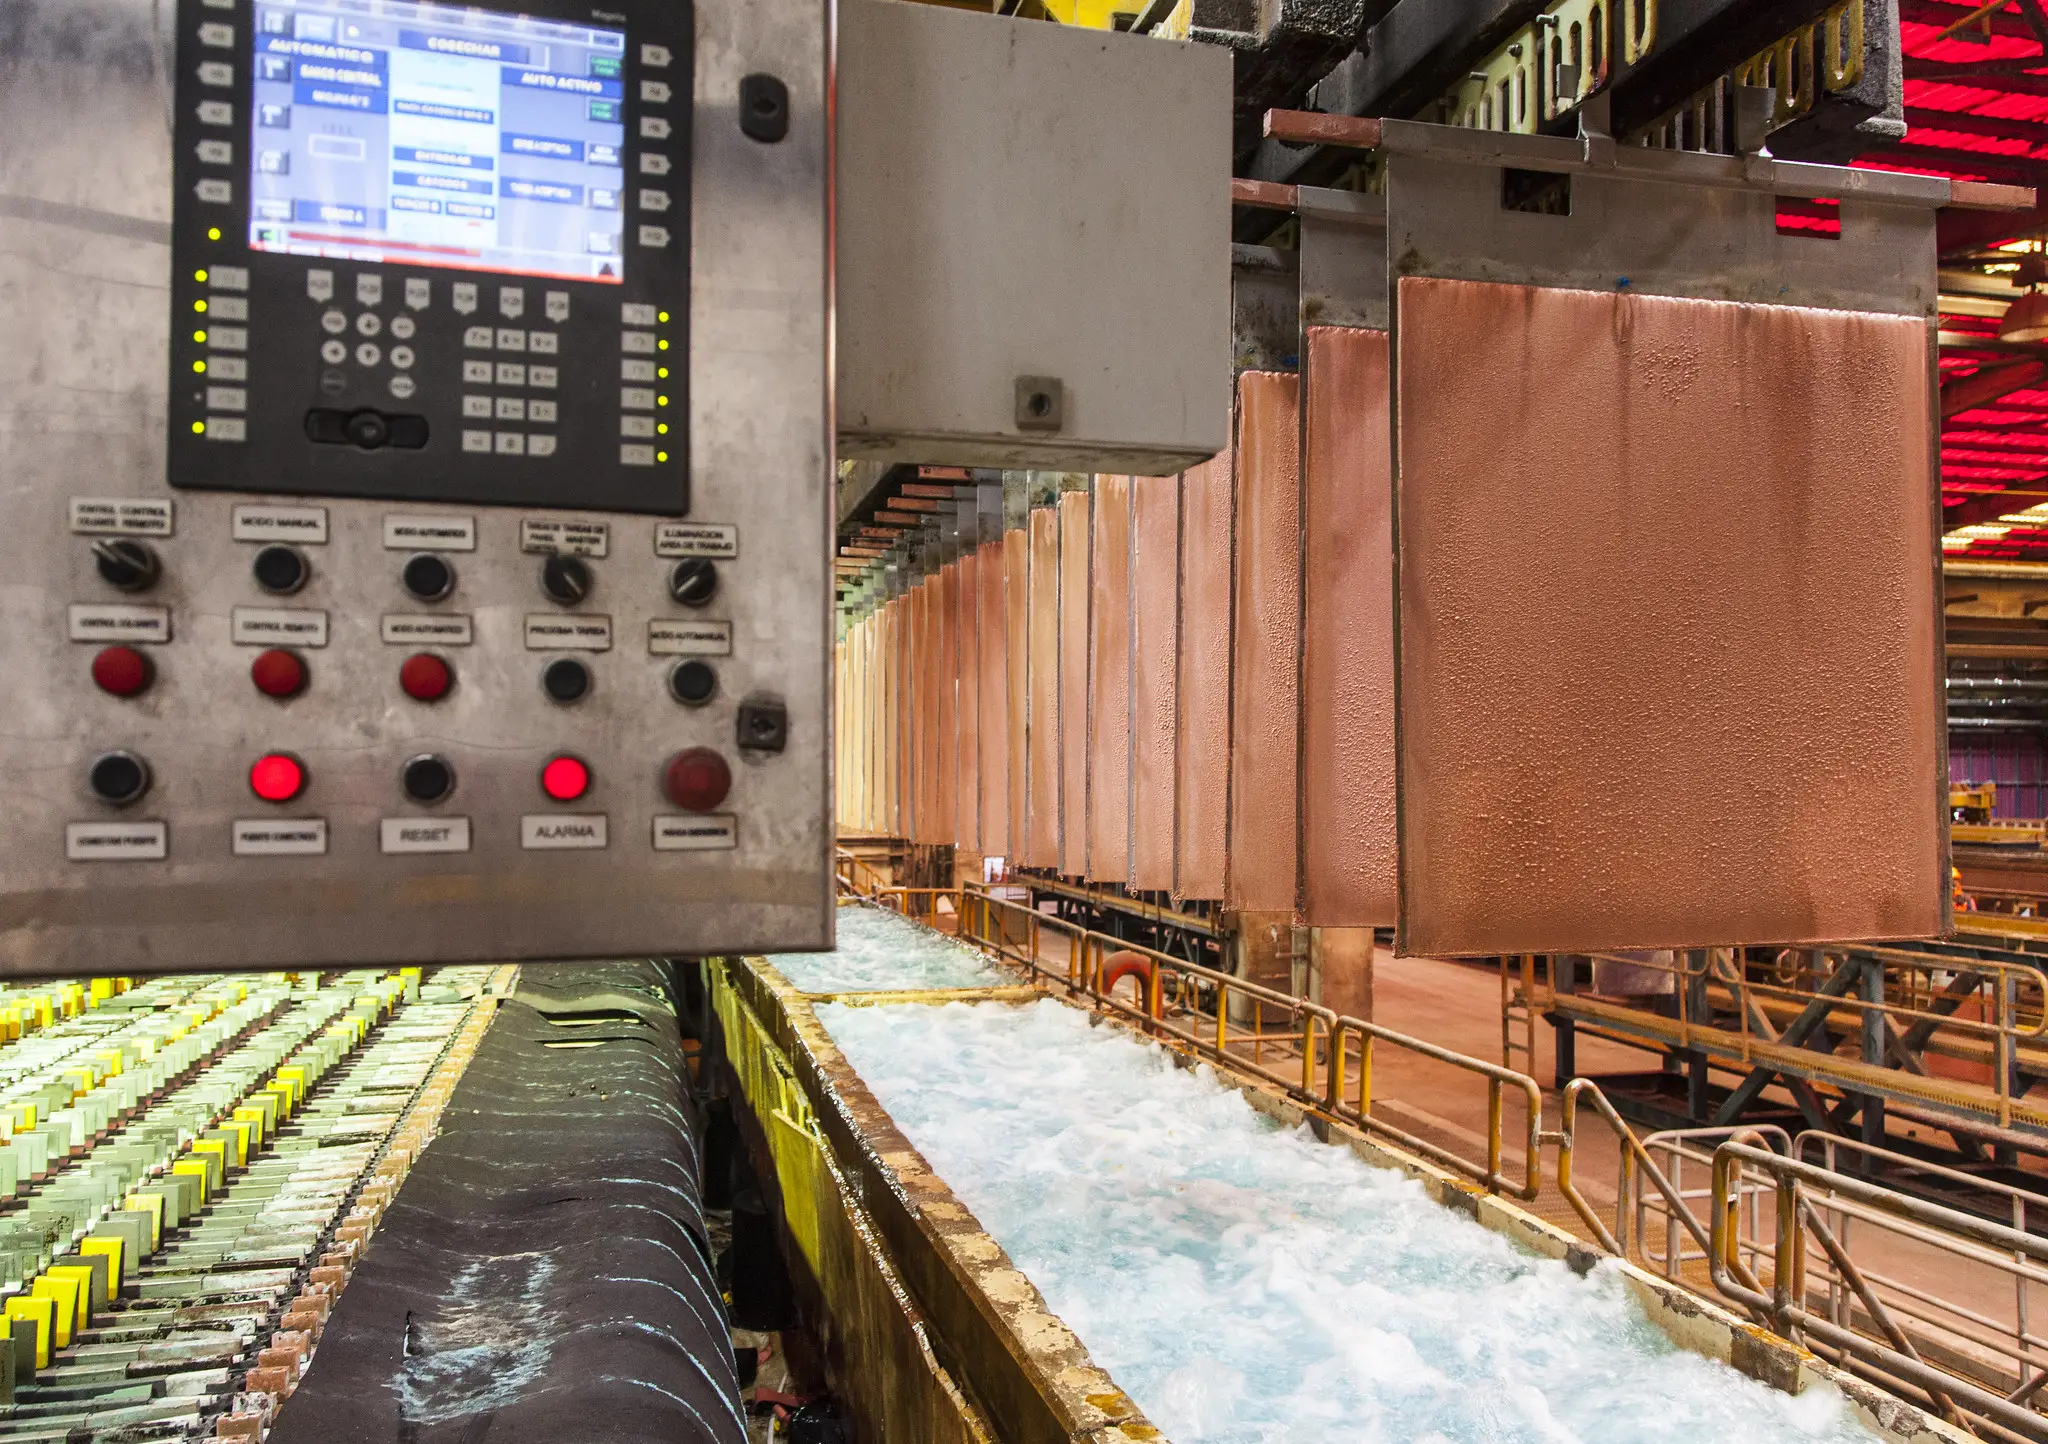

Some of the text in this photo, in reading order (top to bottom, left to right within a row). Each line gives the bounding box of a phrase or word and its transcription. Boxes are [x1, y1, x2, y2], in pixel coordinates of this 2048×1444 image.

[521, 72, 603, 94] AUTO ACTIVO
[241, 516, 275, 526] MODO
[400, 827, 451, 843] RESET
[534, 823, 597, 840] ALARMA
